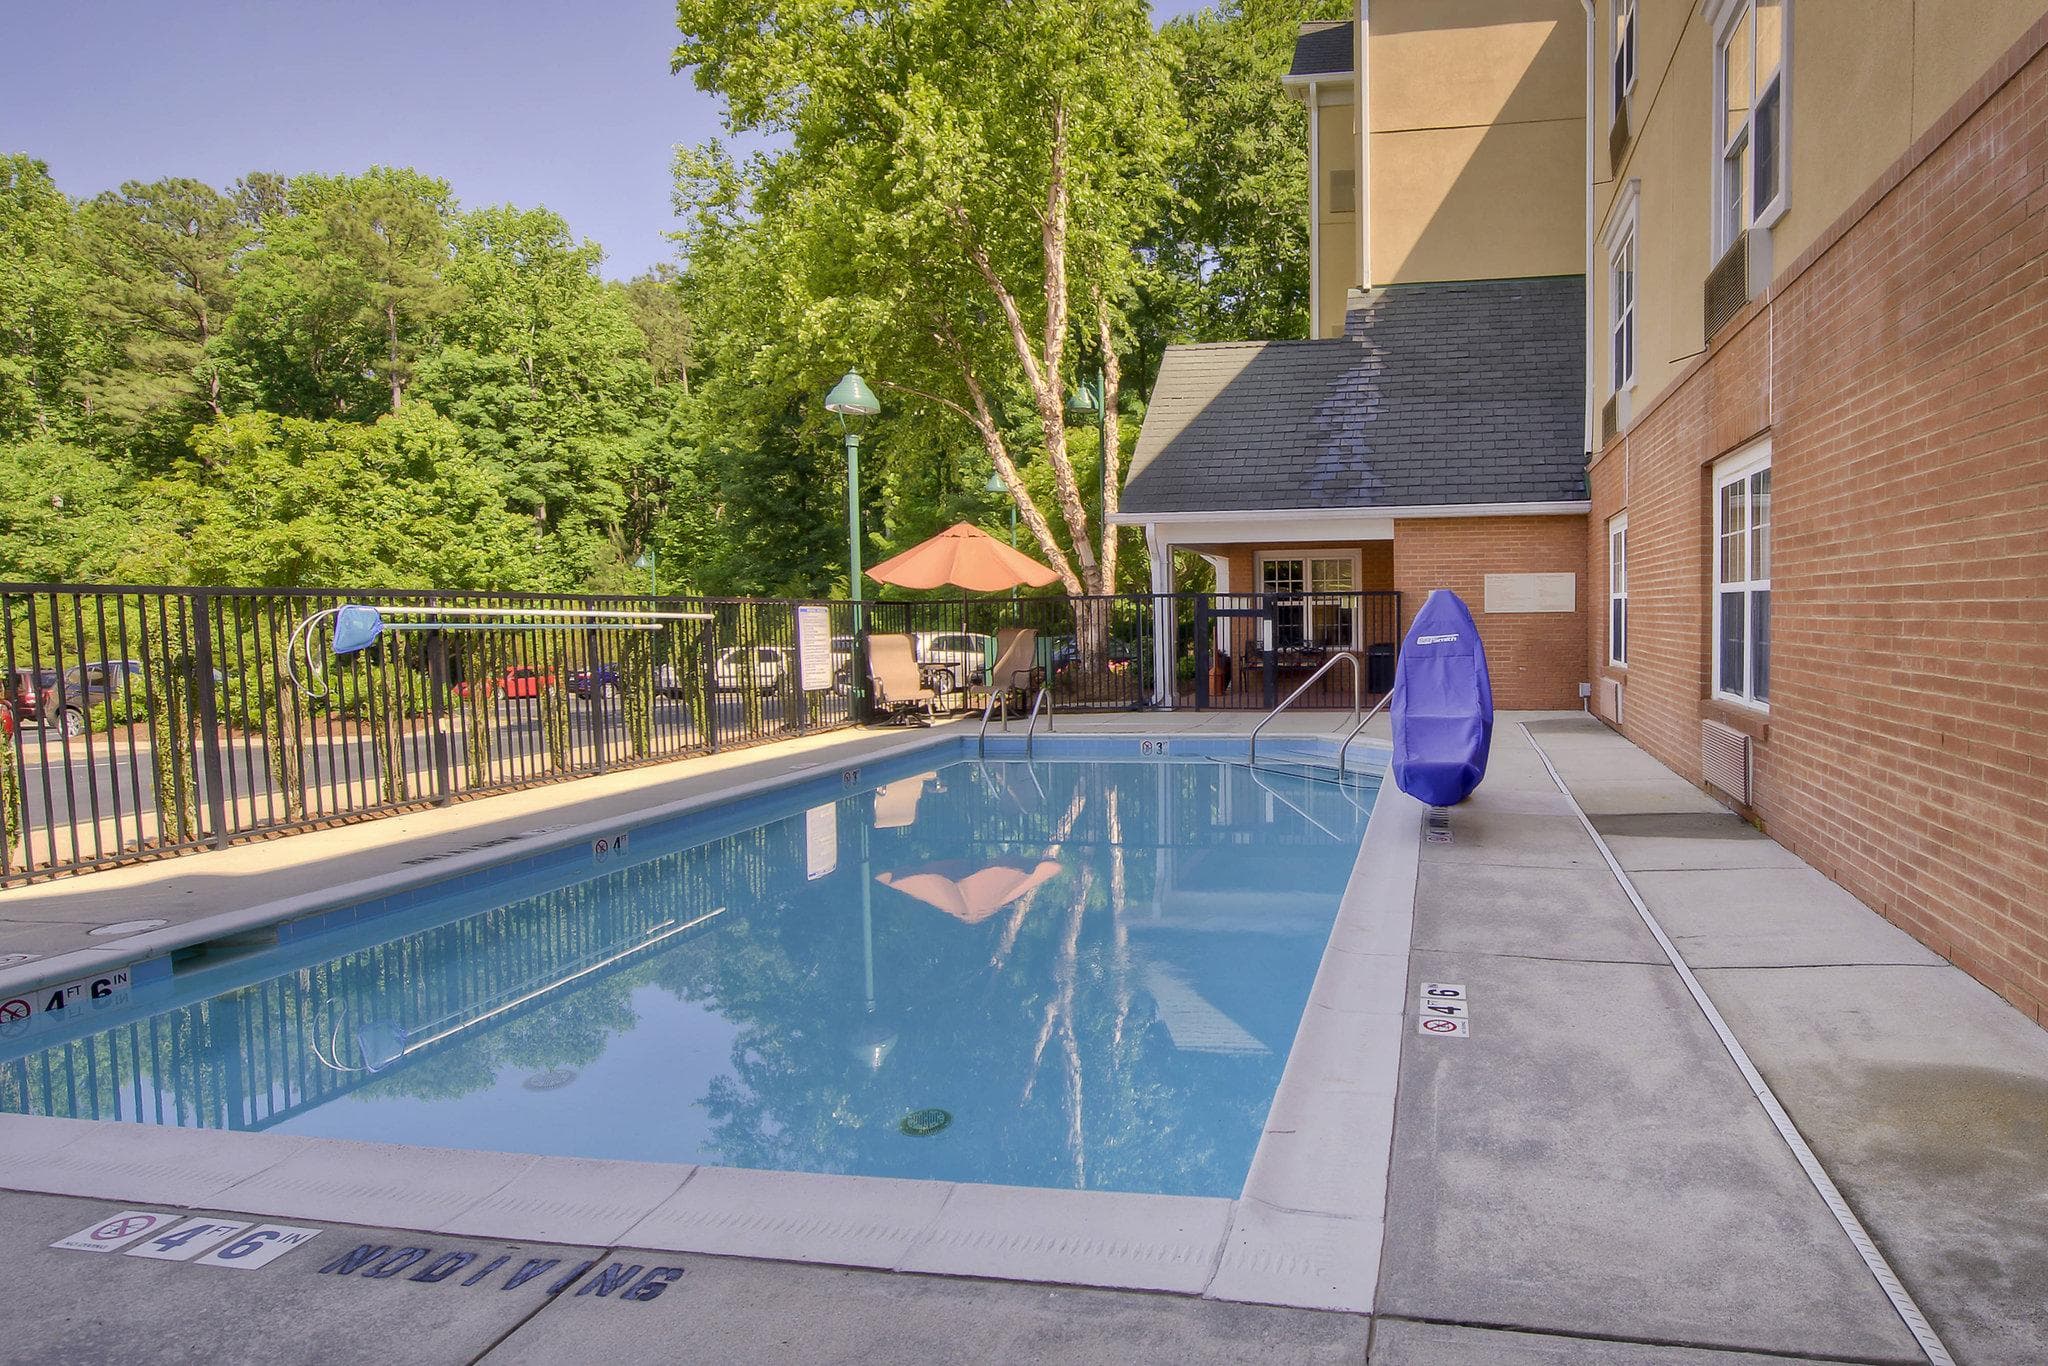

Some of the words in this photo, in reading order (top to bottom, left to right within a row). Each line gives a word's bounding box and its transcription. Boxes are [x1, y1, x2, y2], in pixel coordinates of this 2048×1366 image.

[44, 989, 68, 1012] 4
[67, 984, 81, 998] FT
[91, 978, 112, 999] 6
[114, 973, 127, 984] IN
[1427, 989, 1460, 997] 6
[1427, 1005, 1461, 1015] 4
[206, 1226, 240, 1237] FT
[152, 1224, 216, 1252] 4
[279, 1233, 309, 1245] IN
[217, 1230, 281, 1260] 6
